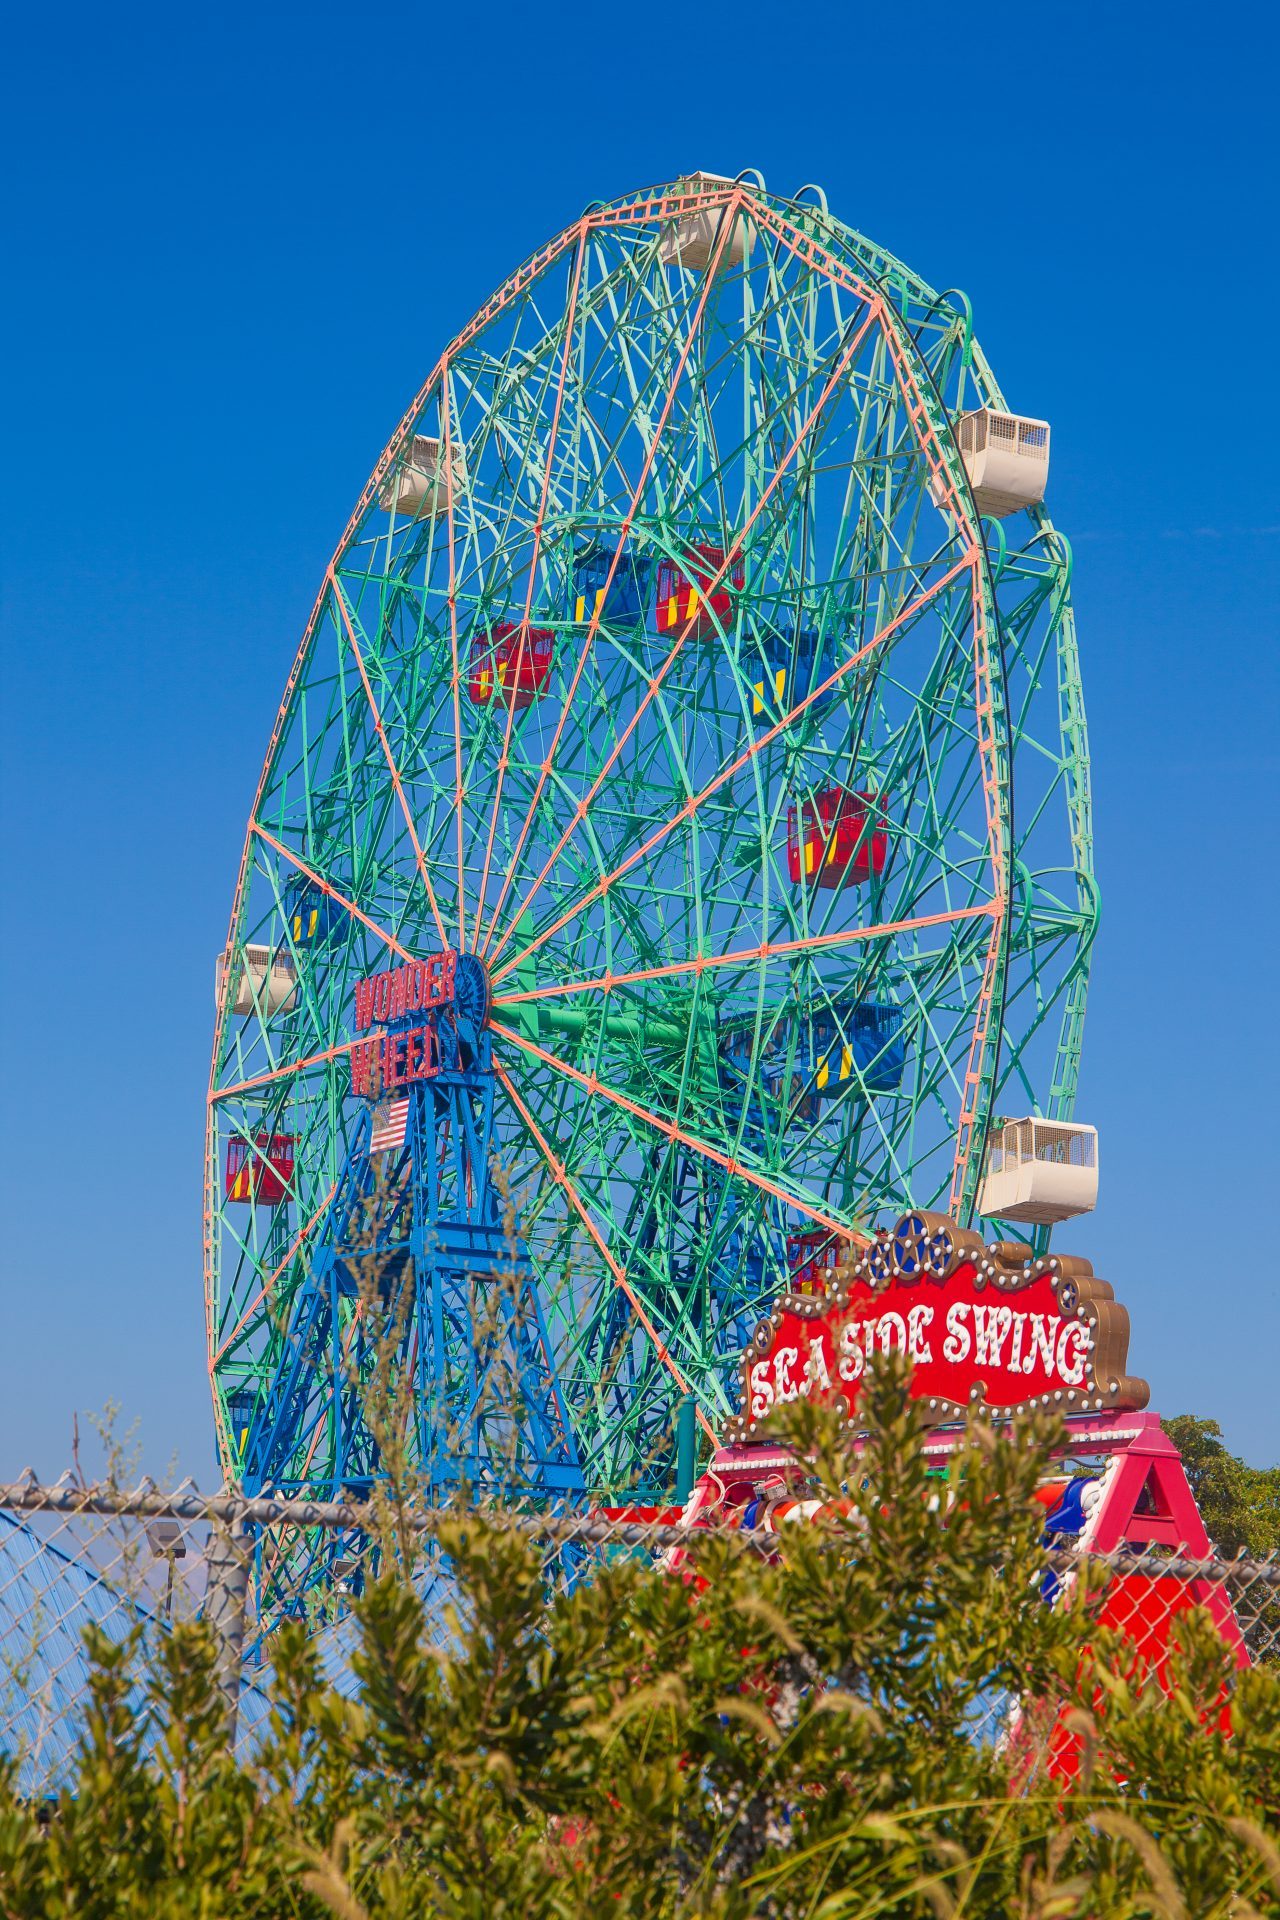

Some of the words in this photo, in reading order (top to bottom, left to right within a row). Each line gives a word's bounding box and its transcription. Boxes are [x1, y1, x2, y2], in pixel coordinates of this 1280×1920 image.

[355, 950, 457, 1031] WONDER
[351, 1025, 439, 1095] WHEEL
[943, 1302, 1091, 1385] SWING
